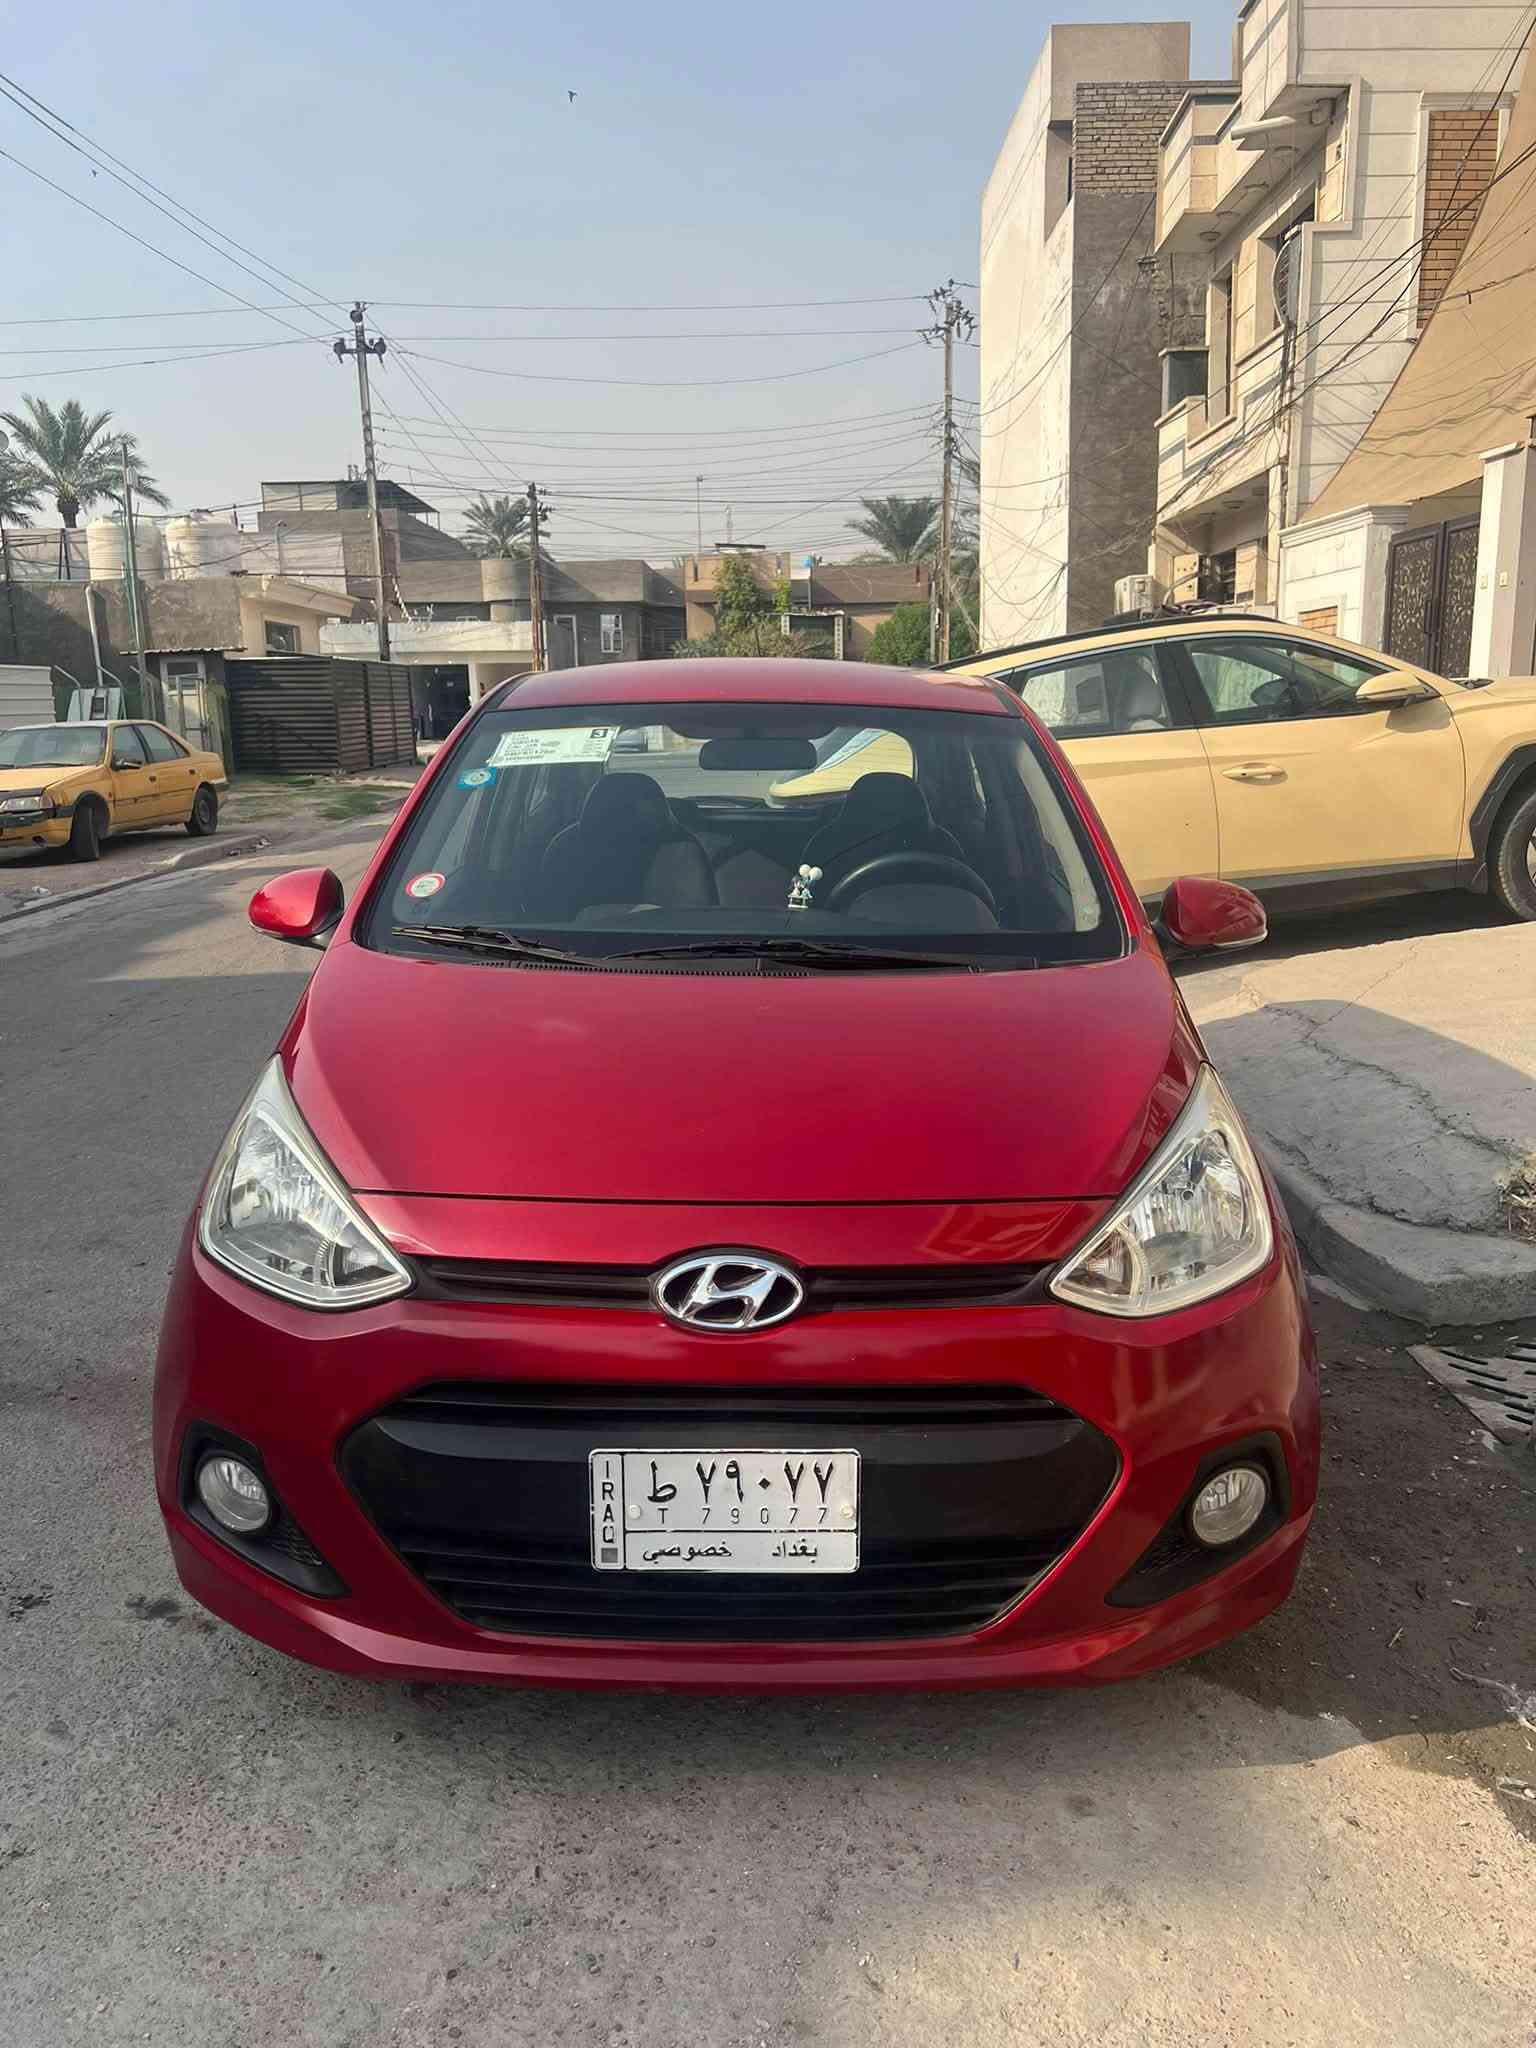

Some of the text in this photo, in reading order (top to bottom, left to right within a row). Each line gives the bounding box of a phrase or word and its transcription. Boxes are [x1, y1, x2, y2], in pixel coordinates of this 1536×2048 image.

[602, 1460, 615, 1543] IRAQ
[643, 1538, 817, 1564] بغداد خصوصي
